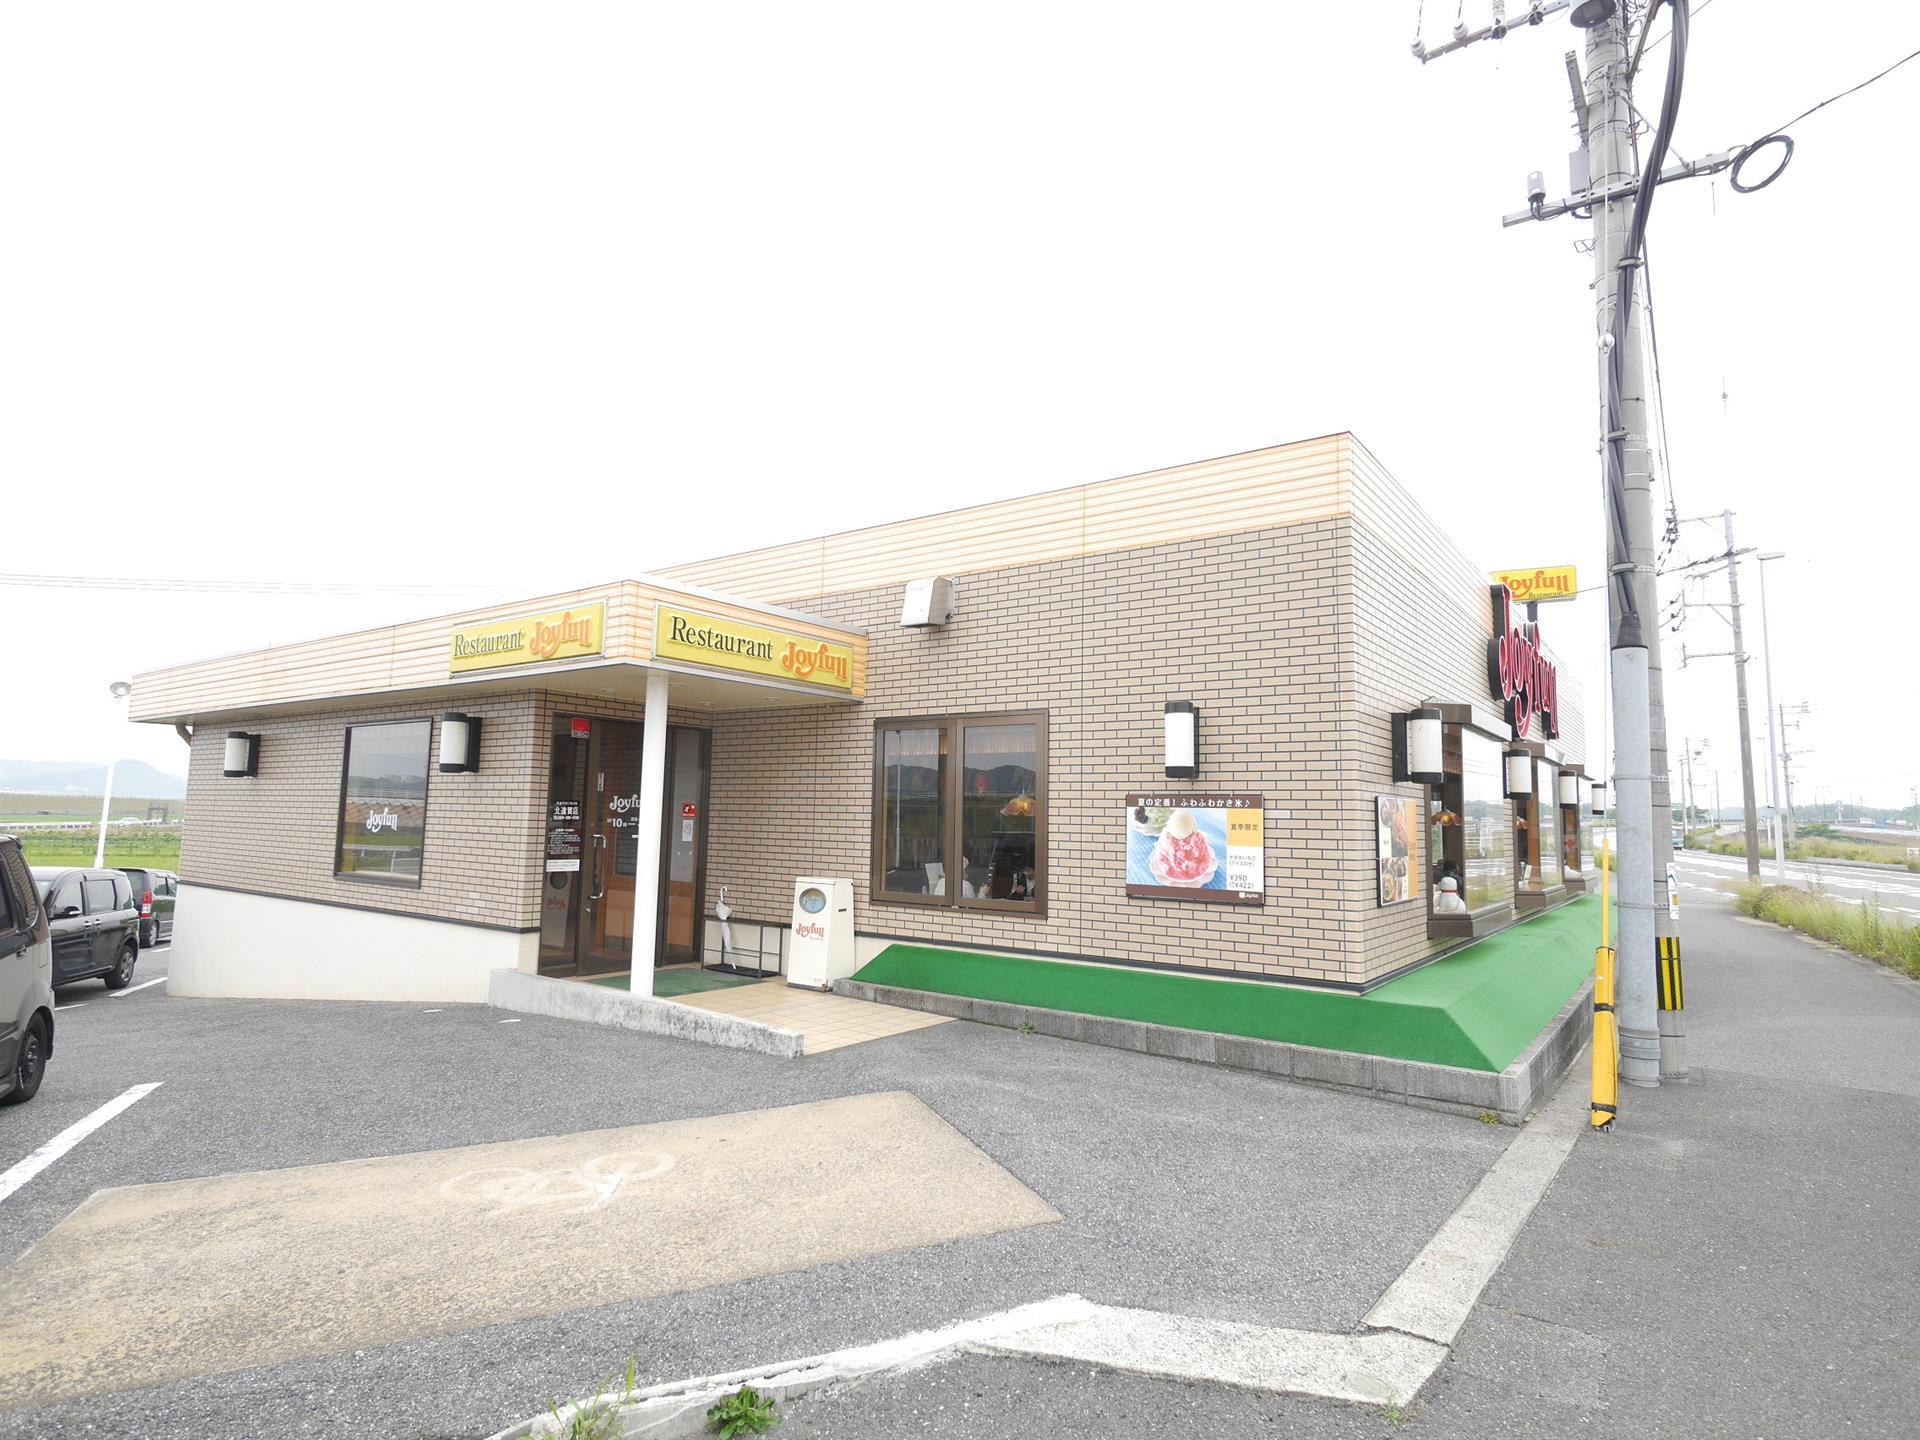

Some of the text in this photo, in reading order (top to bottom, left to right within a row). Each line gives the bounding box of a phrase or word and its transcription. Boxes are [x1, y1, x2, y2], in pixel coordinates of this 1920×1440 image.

[454, 611, 592, 659] Restaurant Joyfull
[670, 615, 848, 681] Restaurant Joyfull
[366, 807, 398, 833] Joyfull
[795, 922, 825, 937] Joyfull
